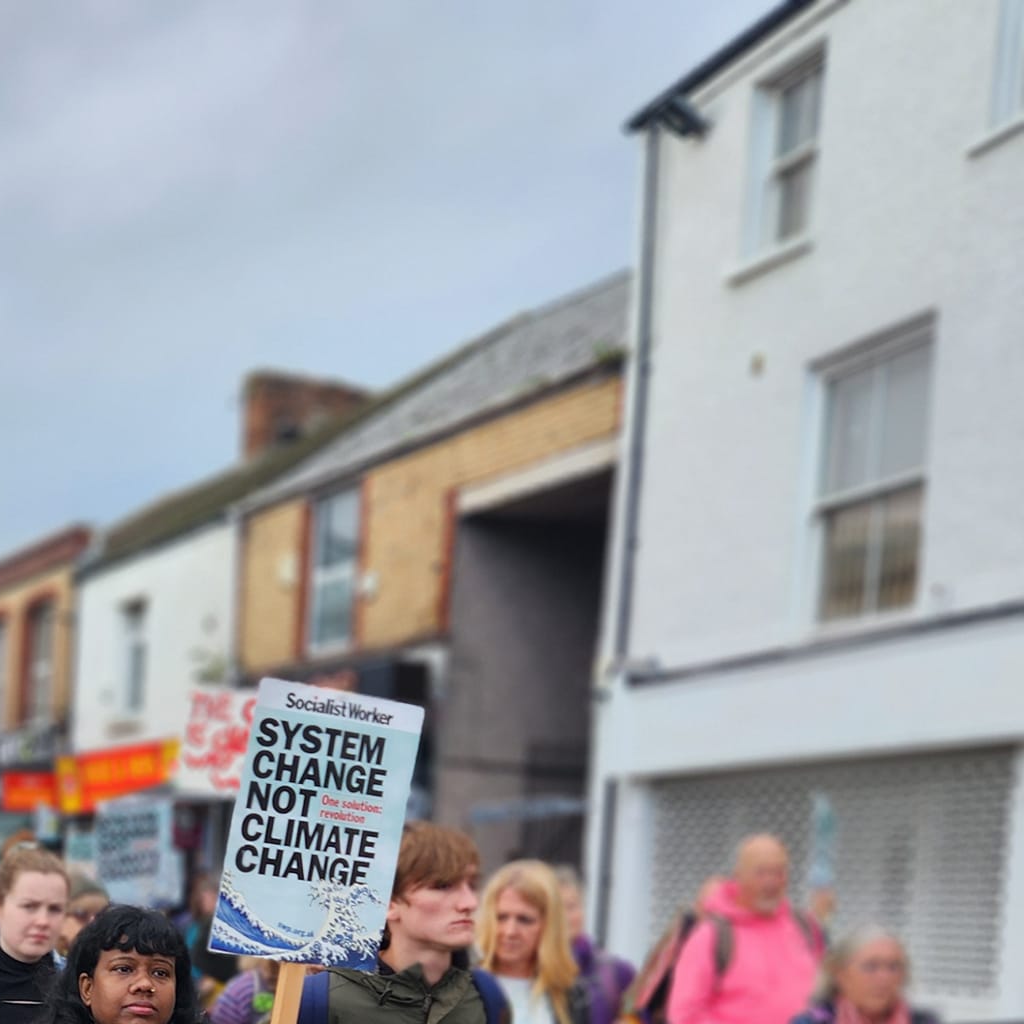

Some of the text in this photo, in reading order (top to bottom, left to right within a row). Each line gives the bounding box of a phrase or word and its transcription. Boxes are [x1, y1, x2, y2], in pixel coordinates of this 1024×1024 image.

[285, 692, 394, 726] Socialist Worker
[256, 717, 386, 765] SYSTEM
[252, 750, 387, 797] CHANGE
[245, 781, 317, 818] NOT
[319, 809, 366, 824] revolution
[321, 794, 383, 814] One solution:
[241, 813, 379, 859] CLIMATE
[235, 844, 370, 886] CHANGE
